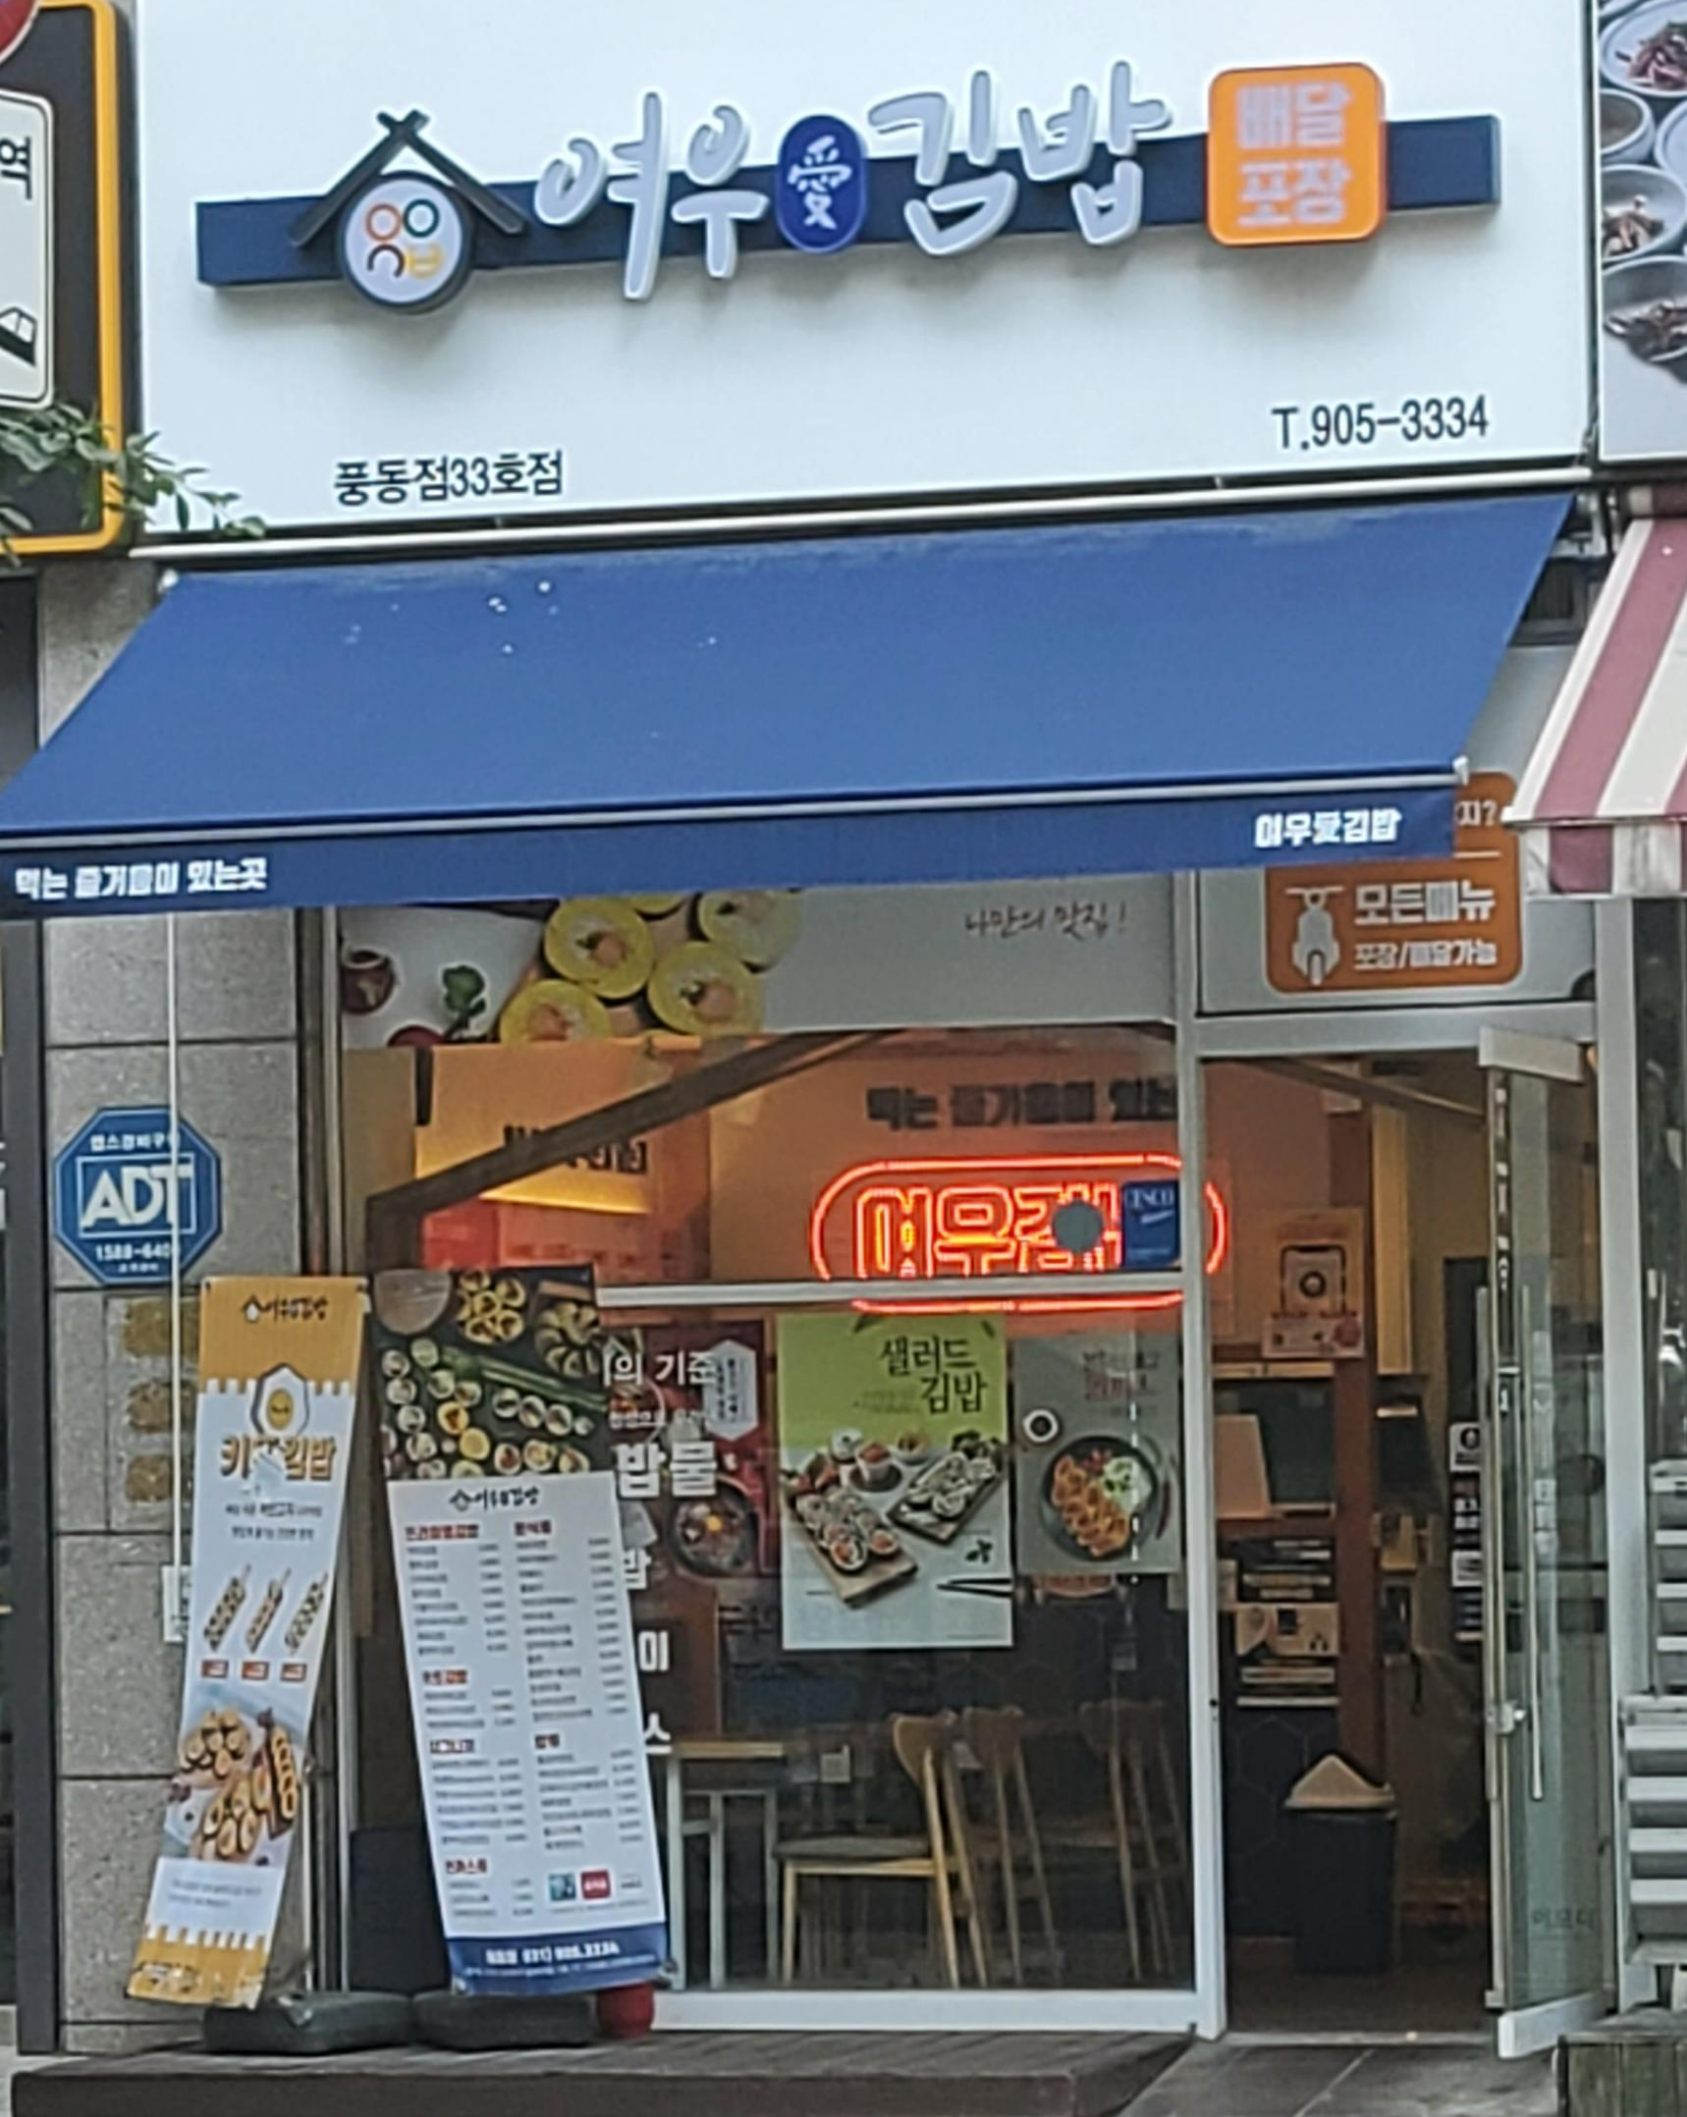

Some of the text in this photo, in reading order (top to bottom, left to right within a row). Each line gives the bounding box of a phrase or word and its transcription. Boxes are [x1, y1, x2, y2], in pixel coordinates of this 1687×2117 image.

[1236, 82, 1352, 149] 배달
[1236, 157, 1353, 229] 포장
[1271, 394, 1489, 451] T.905-3334
[334, 449, 562, 506] 풍동점33호점
[965, 905, 1046, 940] 나만의
[1355, 879, 1496, 925] 모든메뉴
[81, 1164, 193, 1229] ADT
[920, 1371, 988, 1414] 김밥
